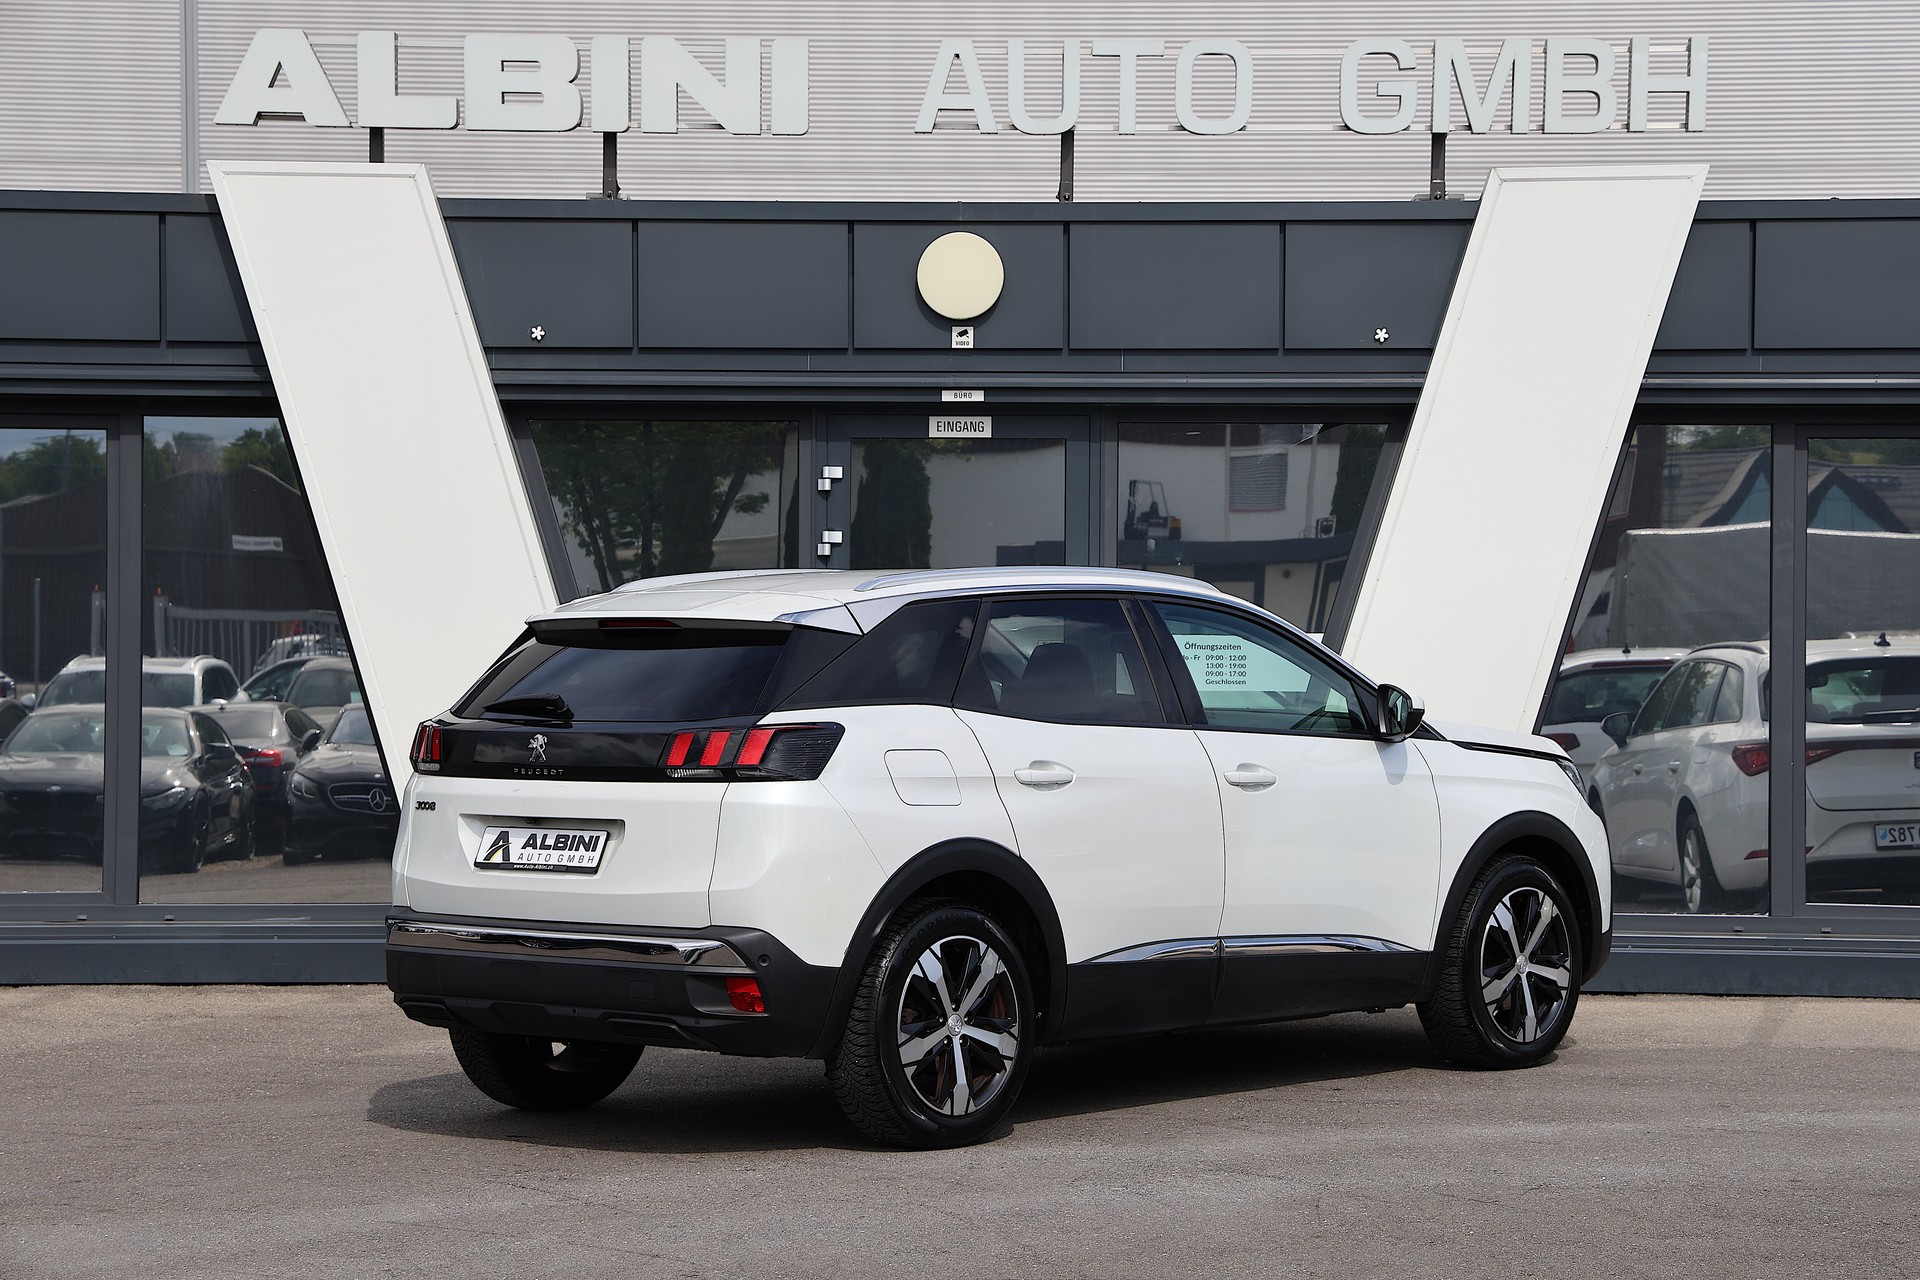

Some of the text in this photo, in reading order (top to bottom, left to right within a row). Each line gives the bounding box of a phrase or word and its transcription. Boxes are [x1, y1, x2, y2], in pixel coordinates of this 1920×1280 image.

[213, 28, 1709, 136] ALBINI AUTO GMBH
[953, 391, 973, 399] BÜRO
[936, 420, 985, 433] EINGANG
[1184, 641, 1242, 651] Öffnungszeiten
[415, 801, 436, 811] 3008
[521, 833, 601, 852] ALBINI
[517, 852, 595, 864] AUTO GMBH
